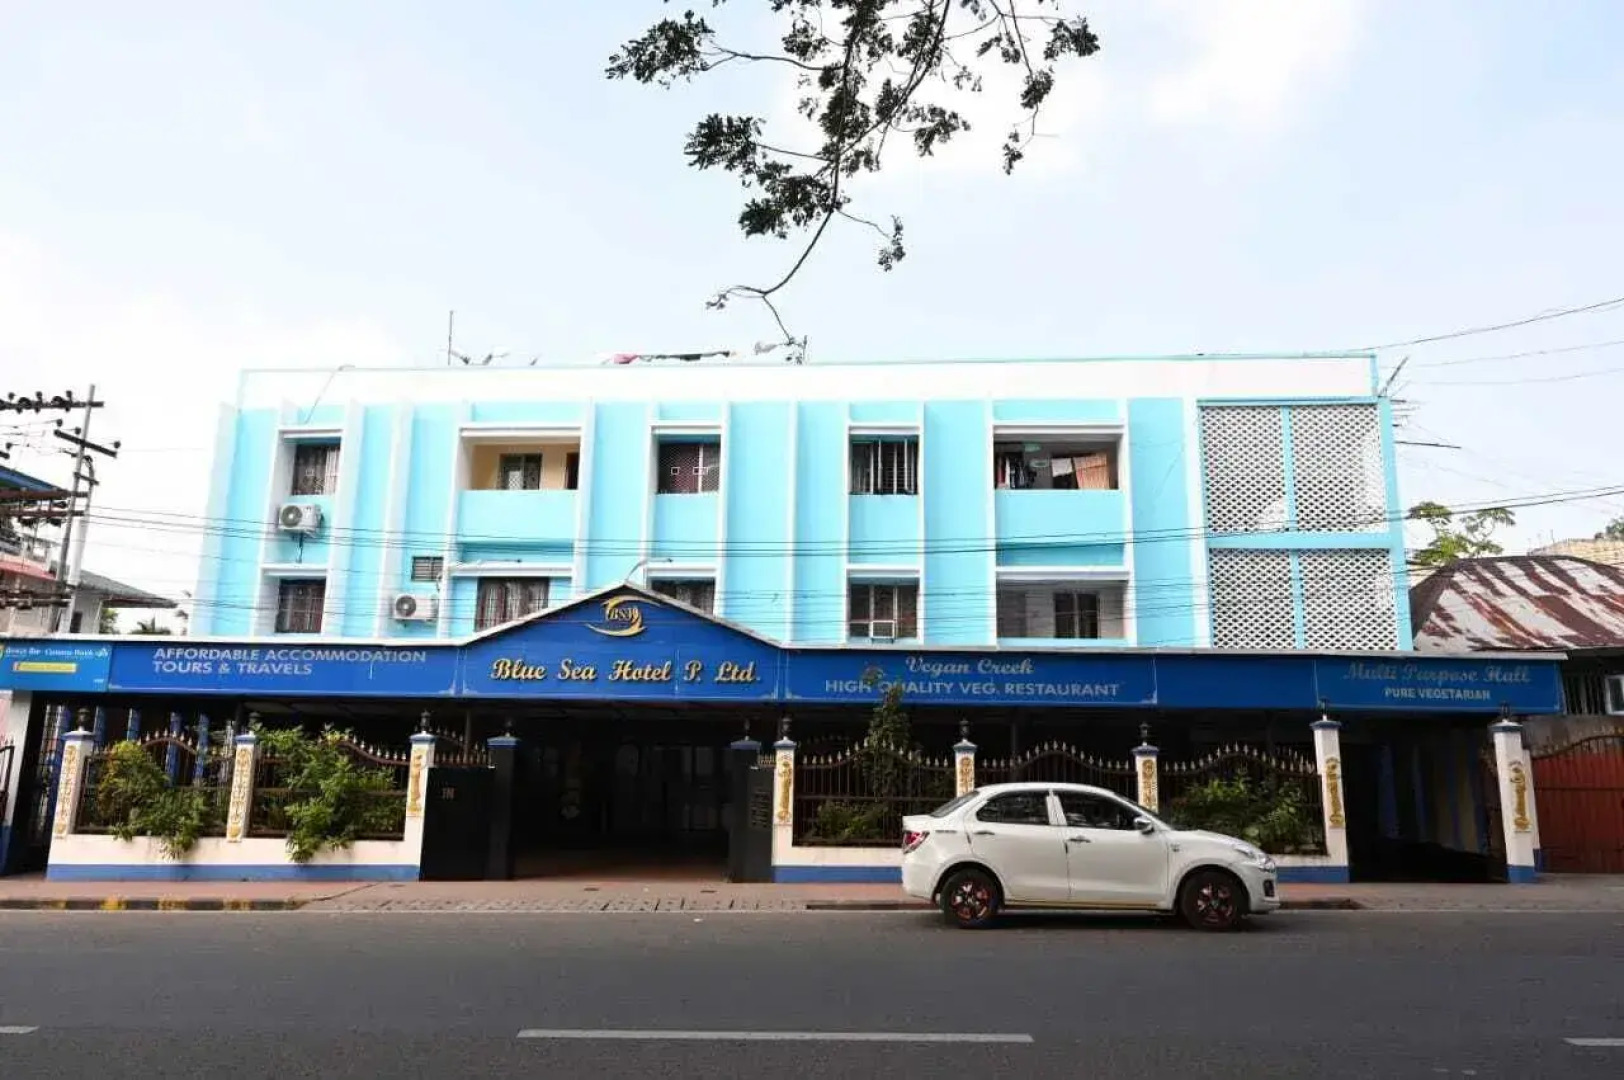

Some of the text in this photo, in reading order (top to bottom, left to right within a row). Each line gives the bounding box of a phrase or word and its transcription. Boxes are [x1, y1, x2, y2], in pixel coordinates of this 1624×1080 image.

[153, 648, 427, 663] AFFORDABLE ACCOMMODATION
[153, 661, 313, 675] TOURS & TRAVELS
[491, 658, 761, 682] Blue Sea Hotel P. Ltd.
[905, 656, 1035, 676] Vegan Creek
[1343, 663, 1532, 683] Multi Purpose Hall
[825, 679, 873, 693] HIGH
[959, 683, 1000, 695] VEG.
[1005, 683, 1121, 697] RESTAURANT
[1384, 687, 1491, 700] PURE VEGETARIAN
